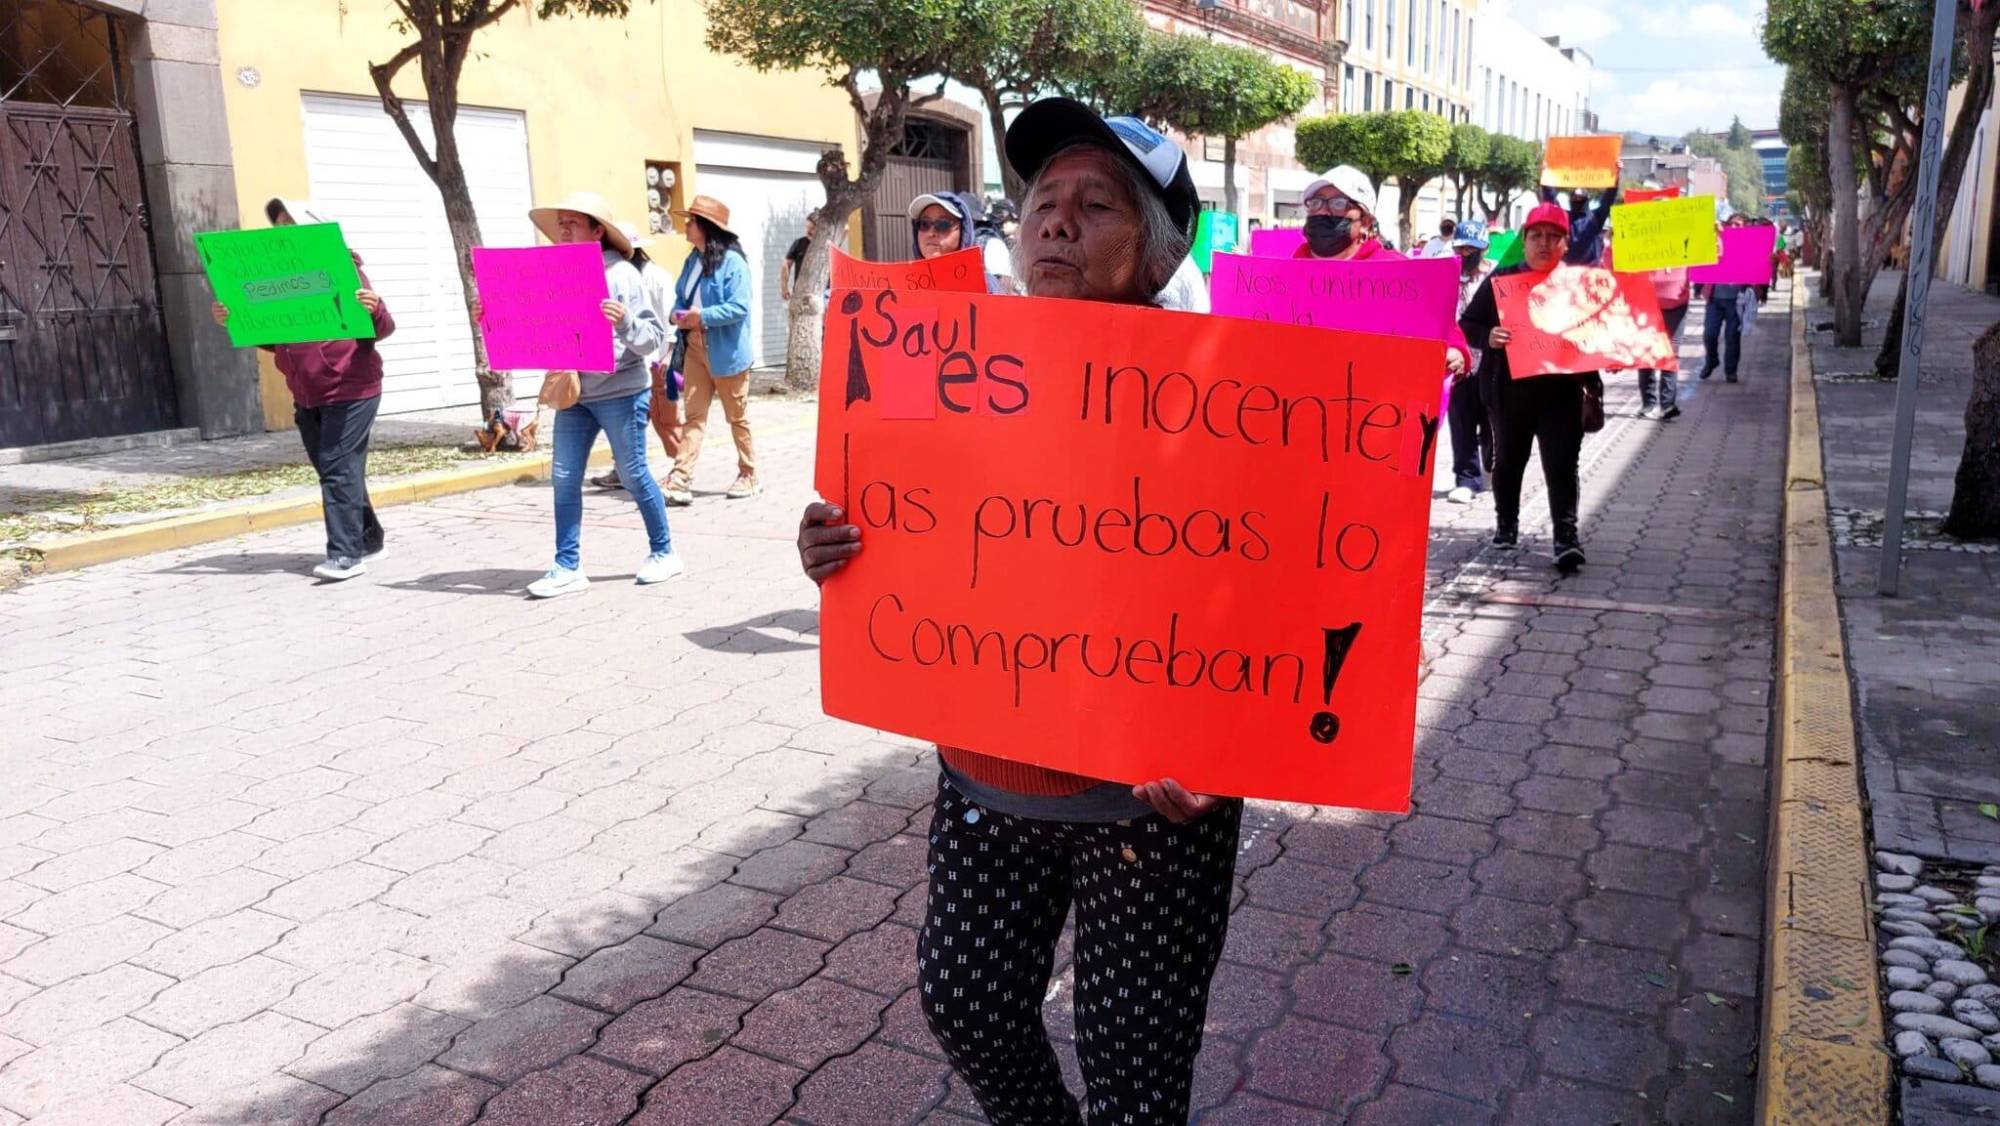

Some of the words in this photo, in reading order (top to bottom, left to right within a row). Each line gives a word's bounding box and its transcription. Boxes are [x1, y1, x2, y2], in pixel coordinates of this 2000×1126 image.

[905, 263, 937, 291] sol
[1235, 264, 1289, 297] Nos
[937, 351, 1030, 415] es
[843, 432, 937, 533] las
[970, 475, 1271, 589] pruebas
[1315, 490, 1381, 572] lo
